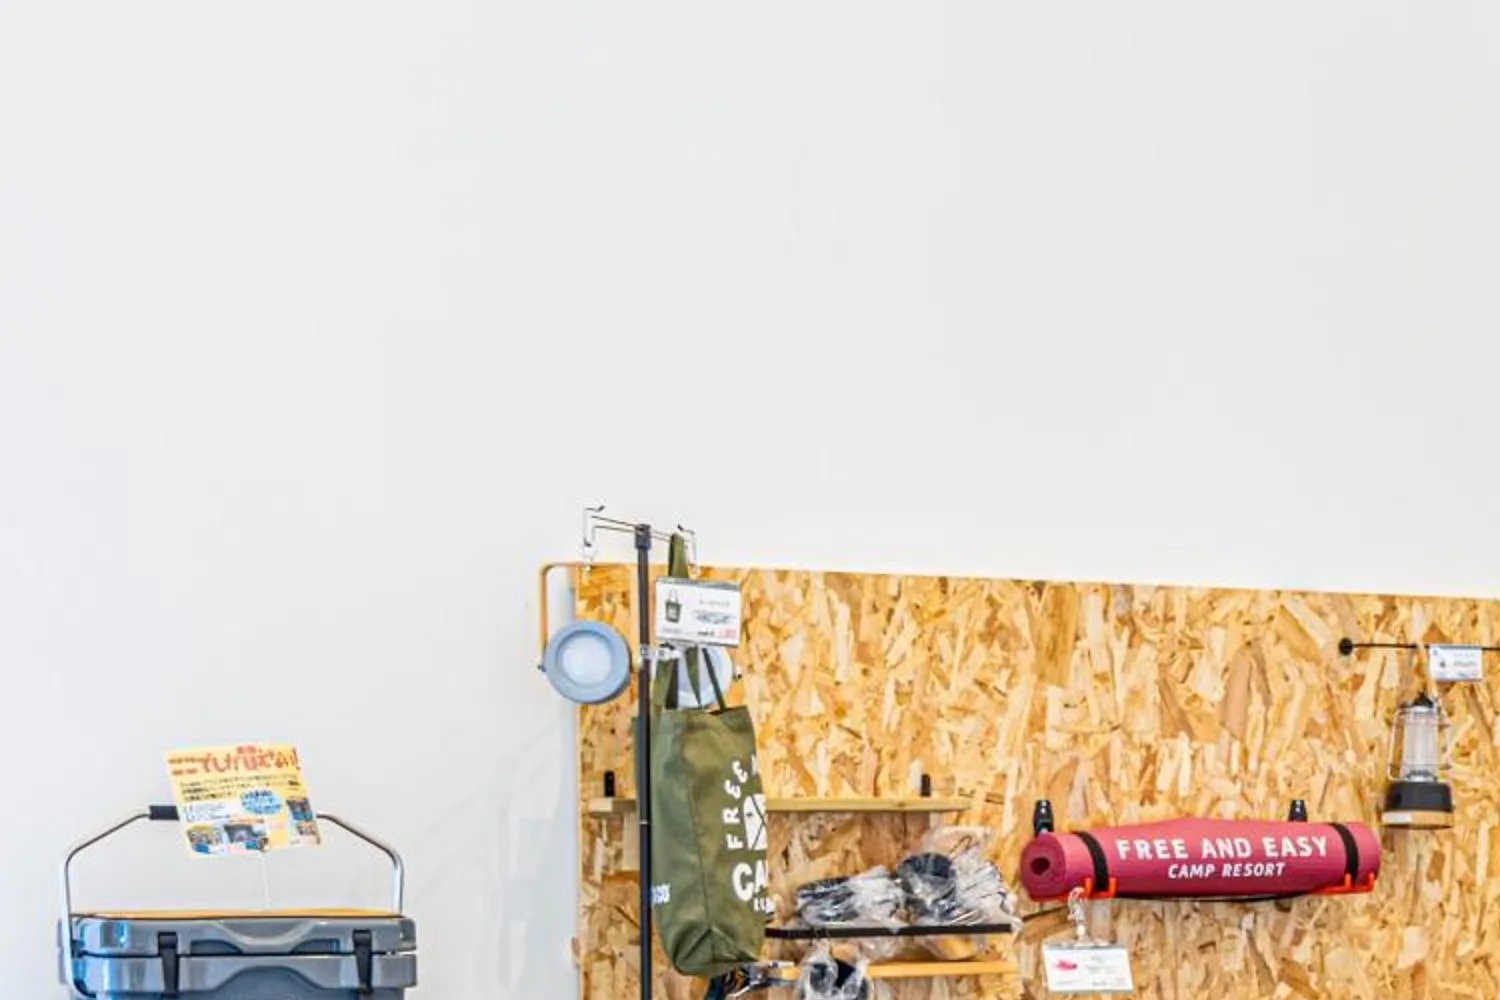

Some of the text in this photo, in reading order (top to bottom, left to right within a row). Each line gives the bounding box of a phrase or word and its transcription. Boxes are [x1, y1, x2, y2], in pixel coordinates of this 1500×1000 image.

[722, 760, 749, 849] FREE
[1115, 836, 1328, 860] FREE AND EASY
[1168, 862, 1286, 879] CAMP RESORT
